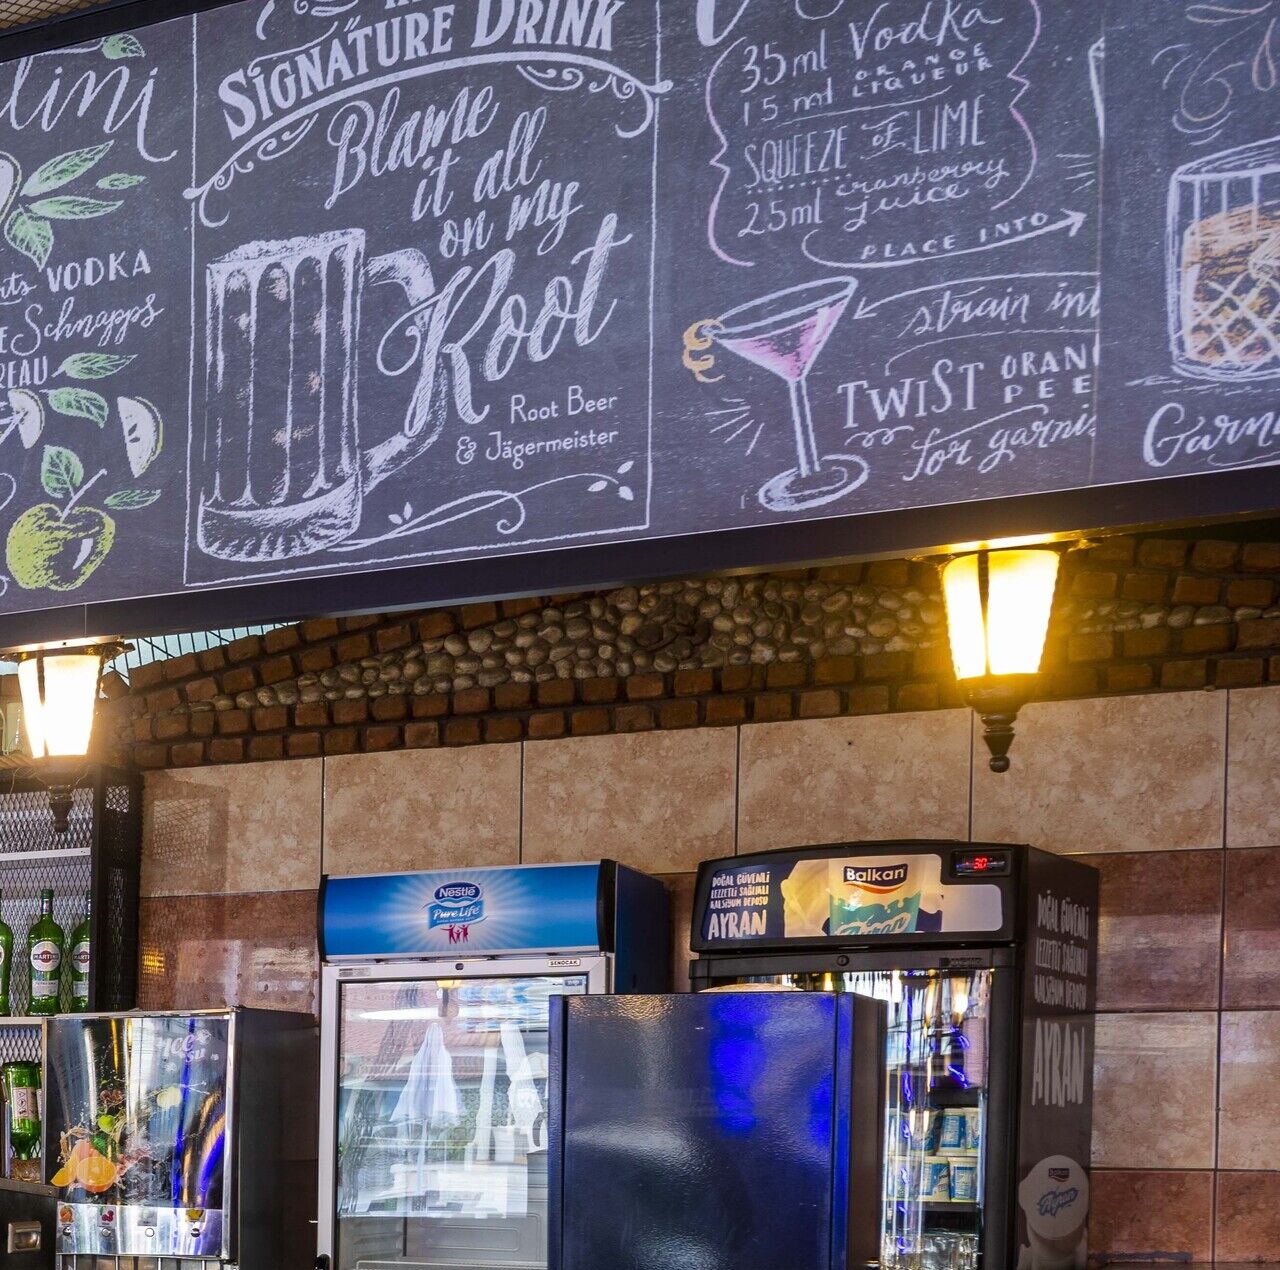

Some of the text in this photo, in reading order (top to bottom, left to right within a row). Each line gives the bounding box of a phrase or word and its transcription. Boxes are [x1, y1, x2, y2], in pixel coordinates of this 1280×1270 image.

[849, 0, 1003, 60] Vodka
[218, 8, 454, 140] SIGNATURE
[325, 86, 500, 209] Blame
[412, 107, 547, 222] it all
[744, 94, 986, 189] SQUEEZE LIME
[440, 180, 585, 258] on my
[843, 182, 970, 231] juice
[861, 212, 1049, 260] PLACE INTO
[47, 250, 151, 294] VODKA
[10, 293, 165, 357] Schnapps
[376, 213, 634, 438] Root
[899, 285, 1030, 338] strain
[510, 385, 618, 425] Root Beer
[837, 359, 986, 429] TWIST
[484, 427, 619, 469] Jägermeister
[846, 868, 904, 882] Balkan
[433, 909, 458, 921] Pure
[459, 906, 480, 918] Life
[707, 909, 768, 940] AYRAN
[33, 952, 59, 961] MARTINI
[1032, 1017, 1085, 1108] AYRAN
